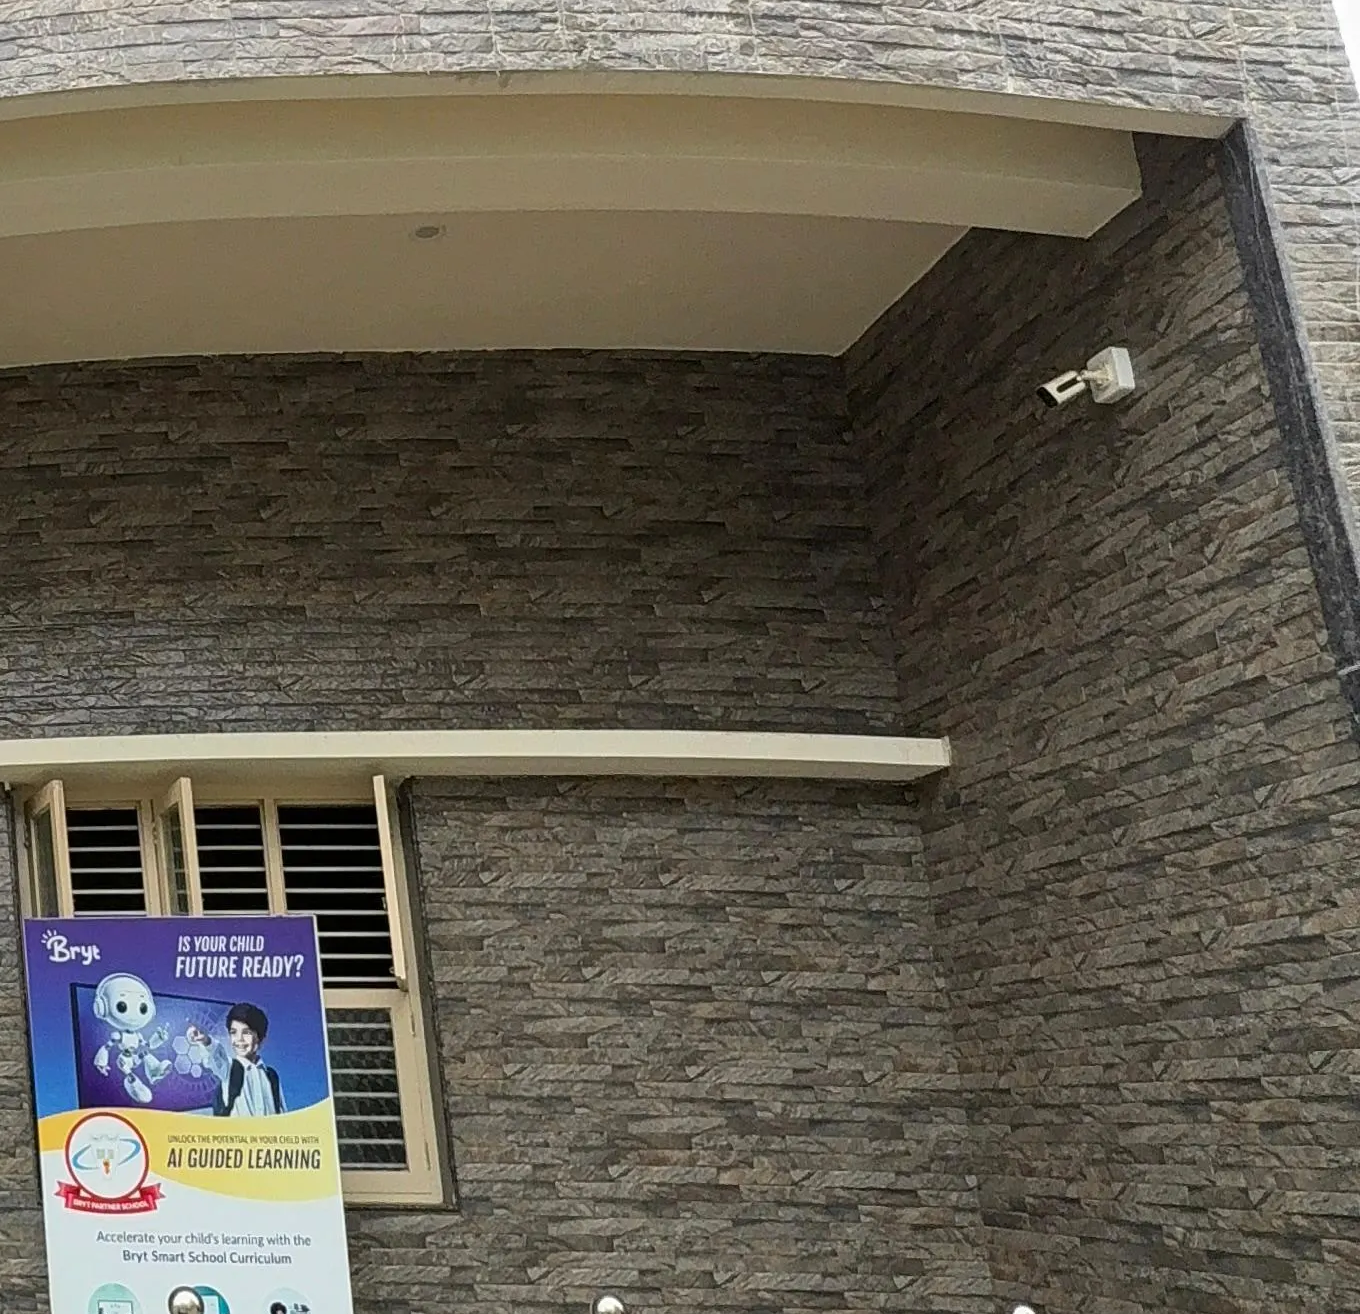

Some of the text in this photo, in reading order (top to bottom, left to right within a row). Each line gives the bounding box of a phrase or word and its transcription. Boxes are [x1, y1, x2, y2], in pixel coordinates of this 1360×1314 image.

[45, 934, 101, 966] Bryt
[177, 935, 265, 953] IS YOUR CHILD
[175, 954, 305, 978] FUTURE READY?
[198, 1134, 211, 1144] THE
[259, 1135, 278, 1144] YOUR
[279, 1135, 300, 1144] CHILD
[301, 1135, 320, 1144] WITH
[167, 1147, 321, 1170] AI GUIDED LEARNING
[96, 1230, 312, 1248] Accelerate your child's learning with the
[122, 1249, 292, 1265] Bryt Smart School Curriculum
